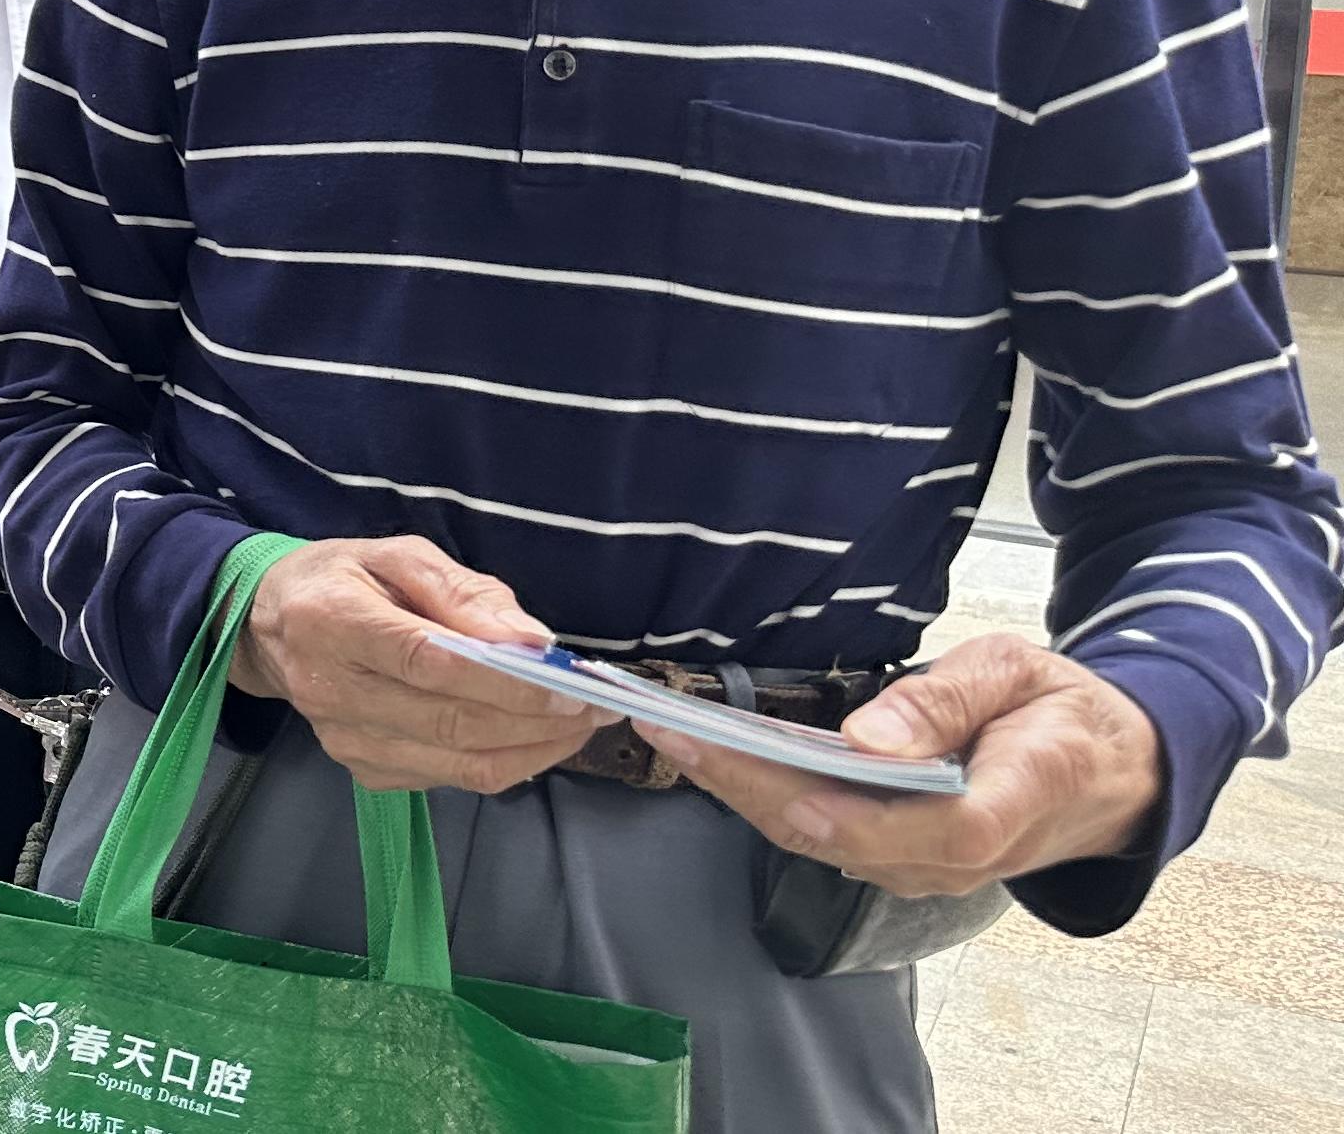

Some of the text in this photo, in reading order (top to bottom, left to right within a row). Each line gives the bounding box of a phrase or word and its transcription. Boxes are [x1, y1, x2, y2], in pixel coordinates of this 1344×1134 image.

[65, 1023, 253, 1104] 春天口腔
[95, 1072, 213, 1116] Spring Dental
